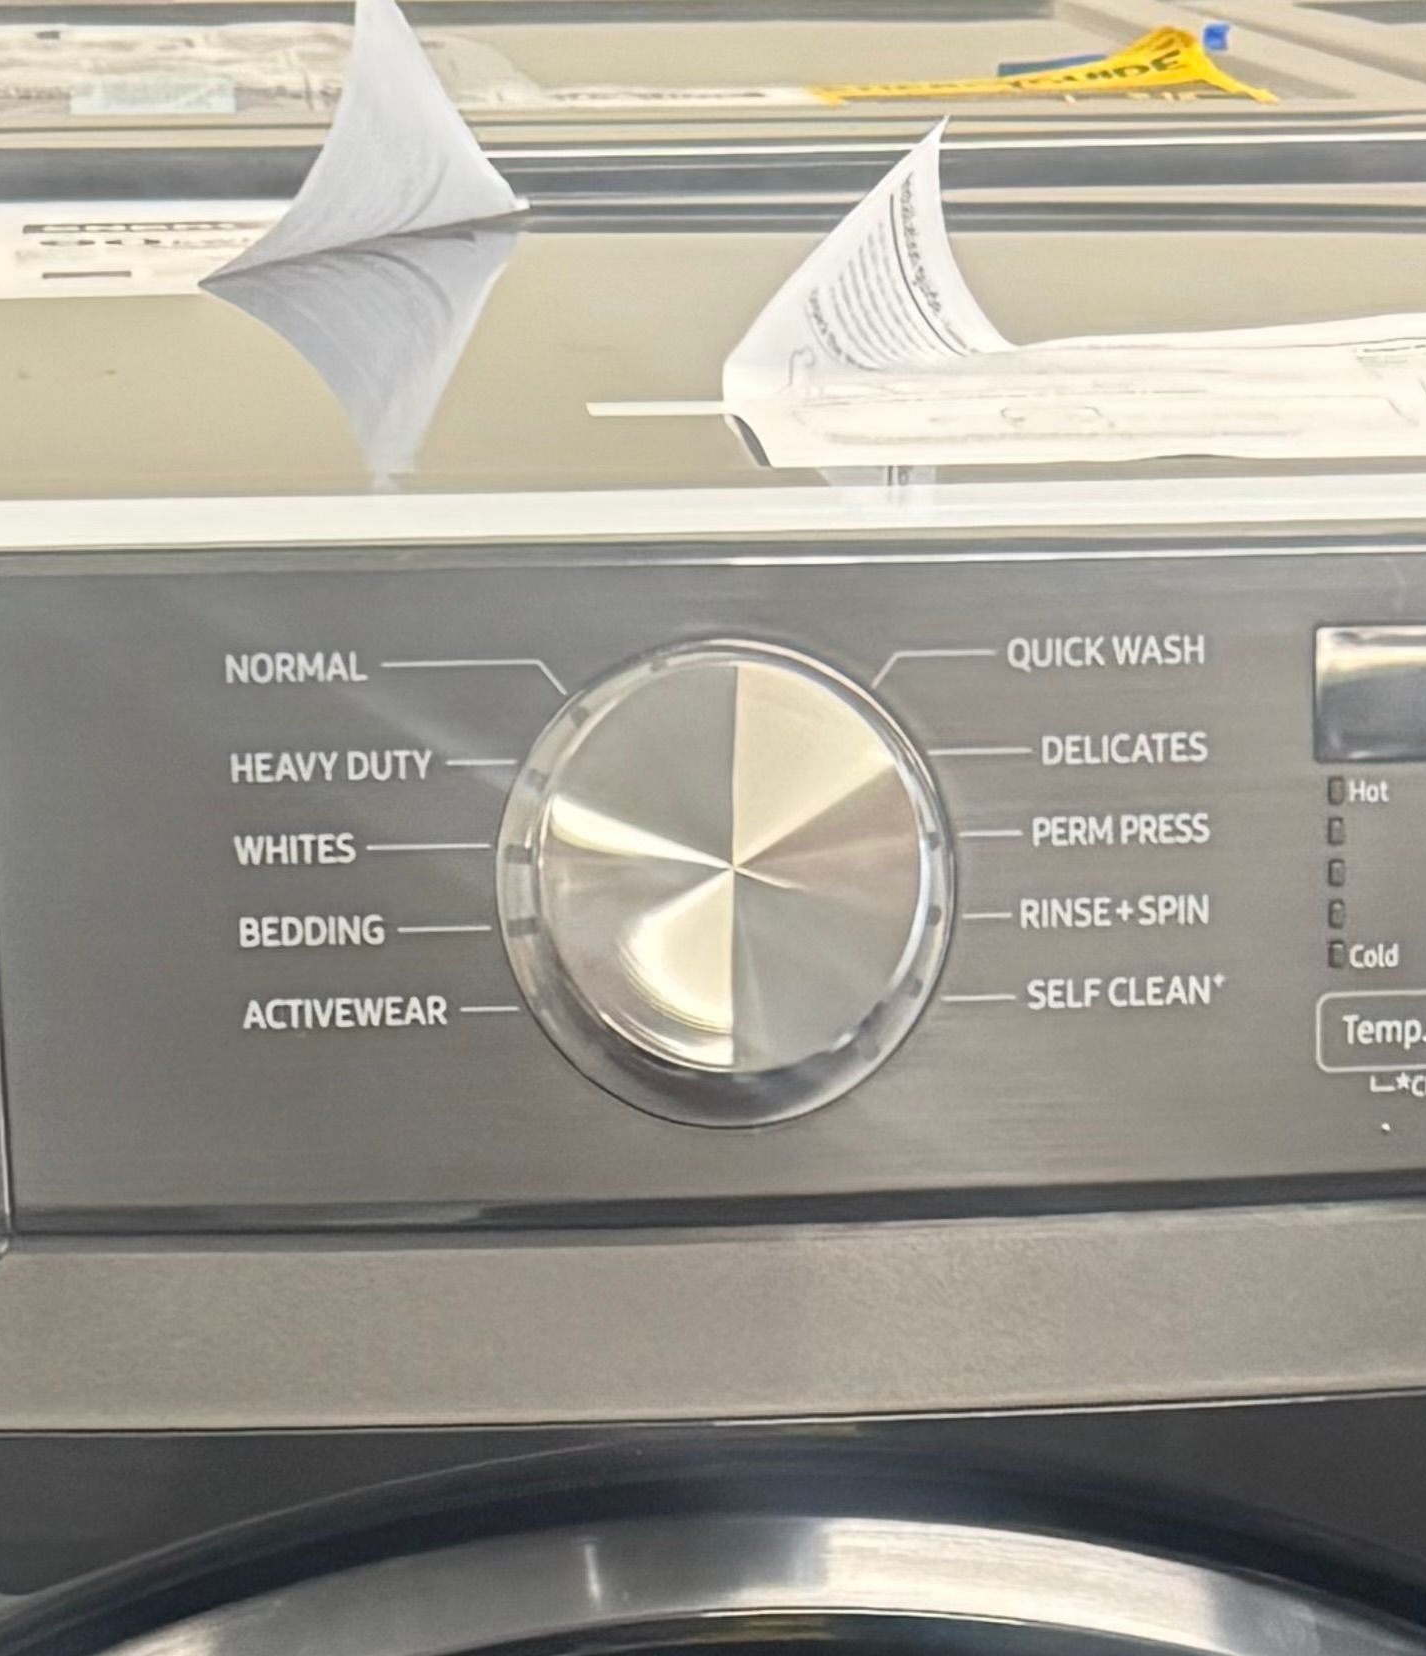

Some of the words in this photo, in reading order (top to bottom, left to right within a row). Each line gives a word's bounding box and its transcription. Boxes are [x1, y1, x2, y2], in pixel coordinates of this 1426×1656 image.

[225, 652, 368, 684] NORMAL
[1007, 637, 1105, 672] QUICK
[1113, 635, 1205, 666] WASH
[1042, 732, 1208, 765] DELICATES
[230, 752, 338, 784] HEAVY
[347, 750, 432, 781] DUTY
[1349, 780, 1389, 803] Hot
[1032, 815, 1113, 846] PERM
[1121, 813, 1210, 845] PRESS
[234, 833, 356, 865] WHITES
[239, 915, 385, 947] BEDDING
[1349, 943, 1399, 969] Cold
[1027, 978, 1101, 1010] SELF
[243, 996, 448, 1029] ACTIVEWEAR
